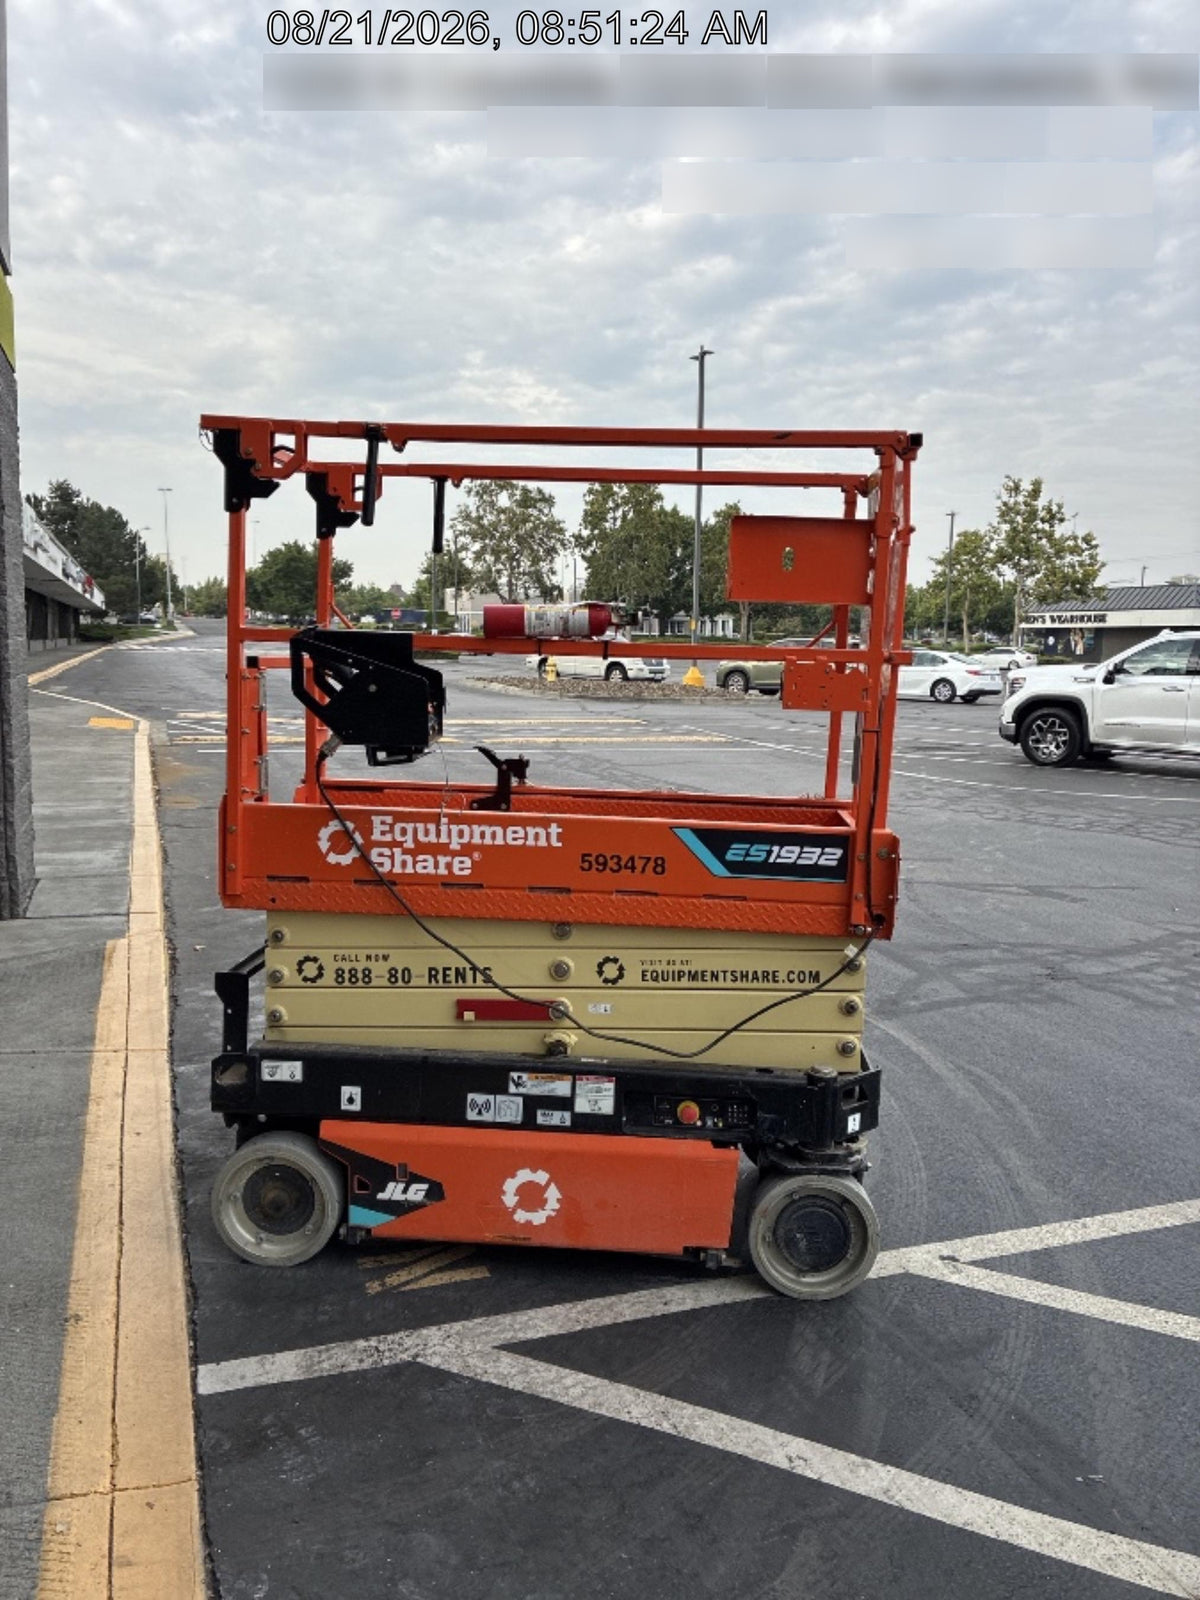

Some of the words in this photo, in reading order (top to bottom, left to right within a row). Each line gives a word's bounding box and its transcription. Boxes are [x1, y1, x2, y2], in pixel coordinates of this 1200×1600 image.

[371, 815, 562, 850] Equipment
[579, 853, 667, 875] 593478
[725, 843, 843, 866] ES1932
[333, 954, 360, 963] CALL
[366, 954, 390, 963] NOW
[641, 969, 821, 984] EQUIPMENTSHARE.COM
[376, 1181, 429, 1201] JLG
